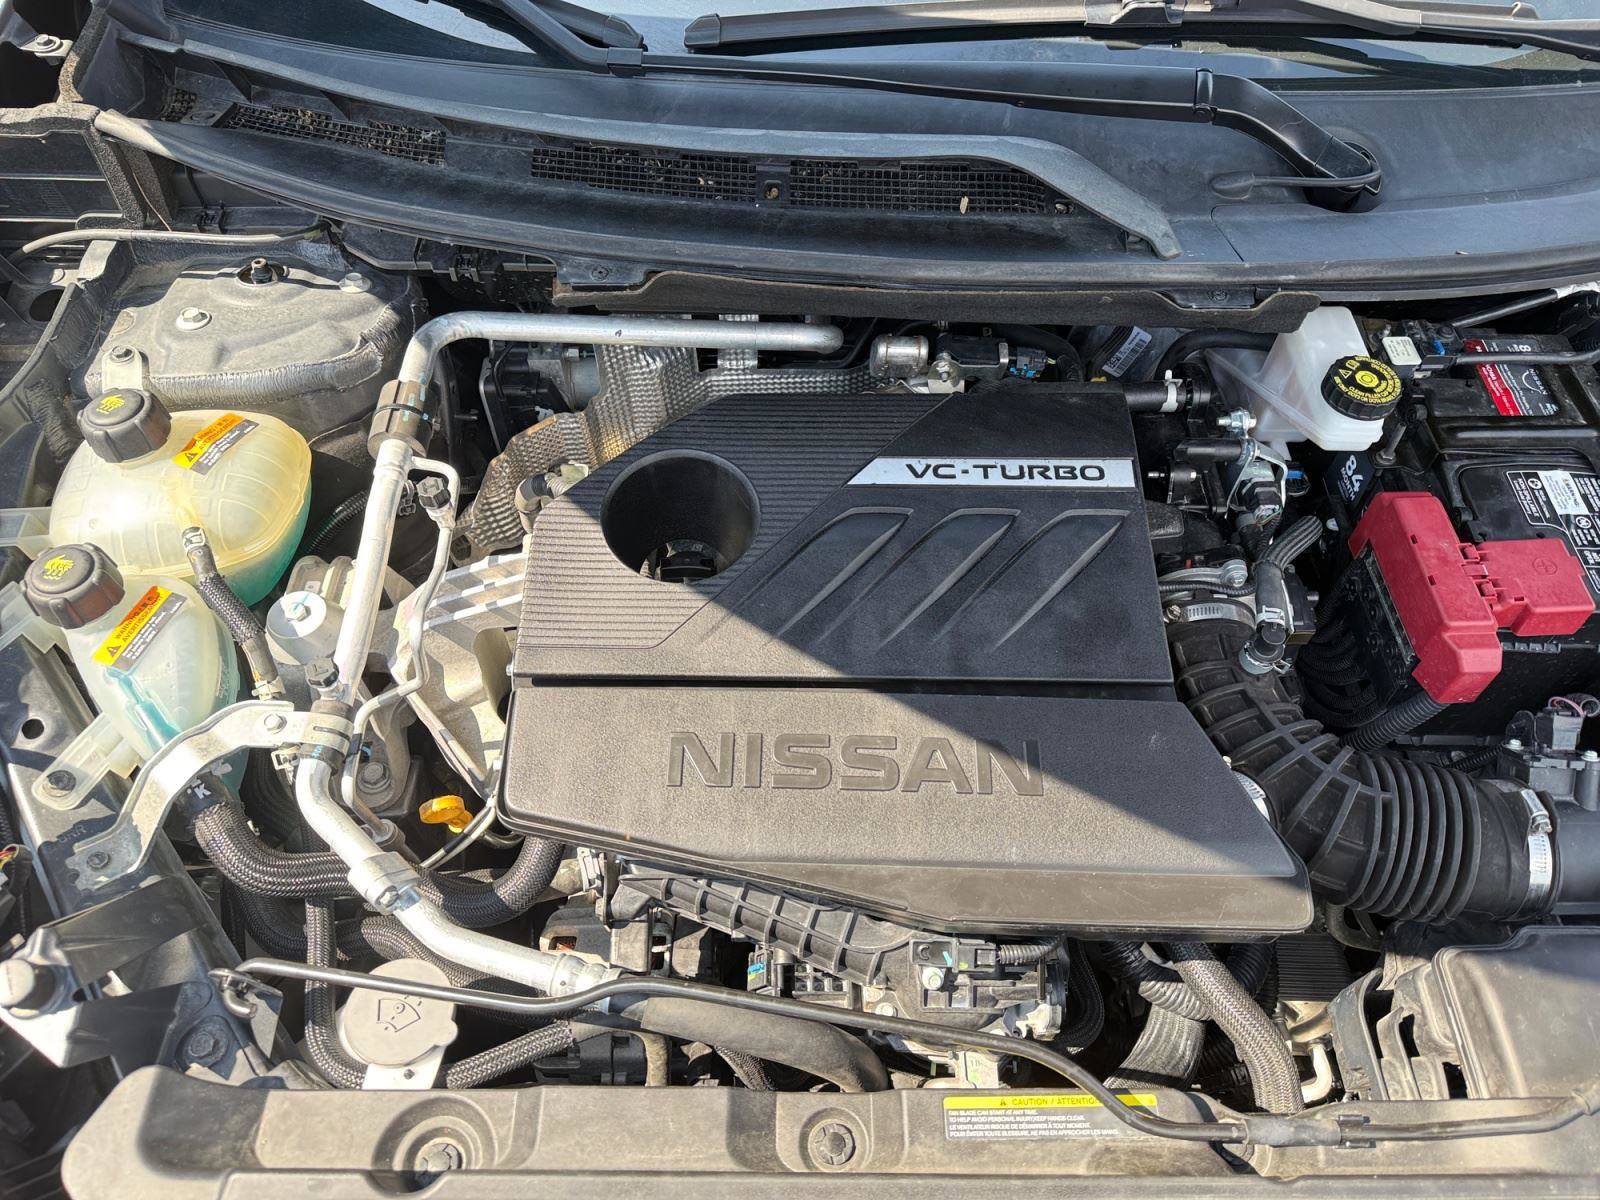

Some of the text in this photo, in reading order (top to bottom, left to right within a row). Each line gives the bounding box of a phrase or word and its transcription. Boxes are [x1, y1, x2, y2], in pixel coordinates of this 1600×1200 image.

[1528, 368, 1548, 395] NISSAN
[906, 464, 1105, 480] VC-TURBO
[1340, 467, 1356, 500] MONTH
[1346, 454, 1364, 492] 84
[1518, 478, 1540, 517] NON-SPILLABLE
[666, 732, 1044, 796] NISSAN
[1012, 1098, 1048, 1106] CAUTION
[1057, 1097, 1096, 1105] ATTENTIO
